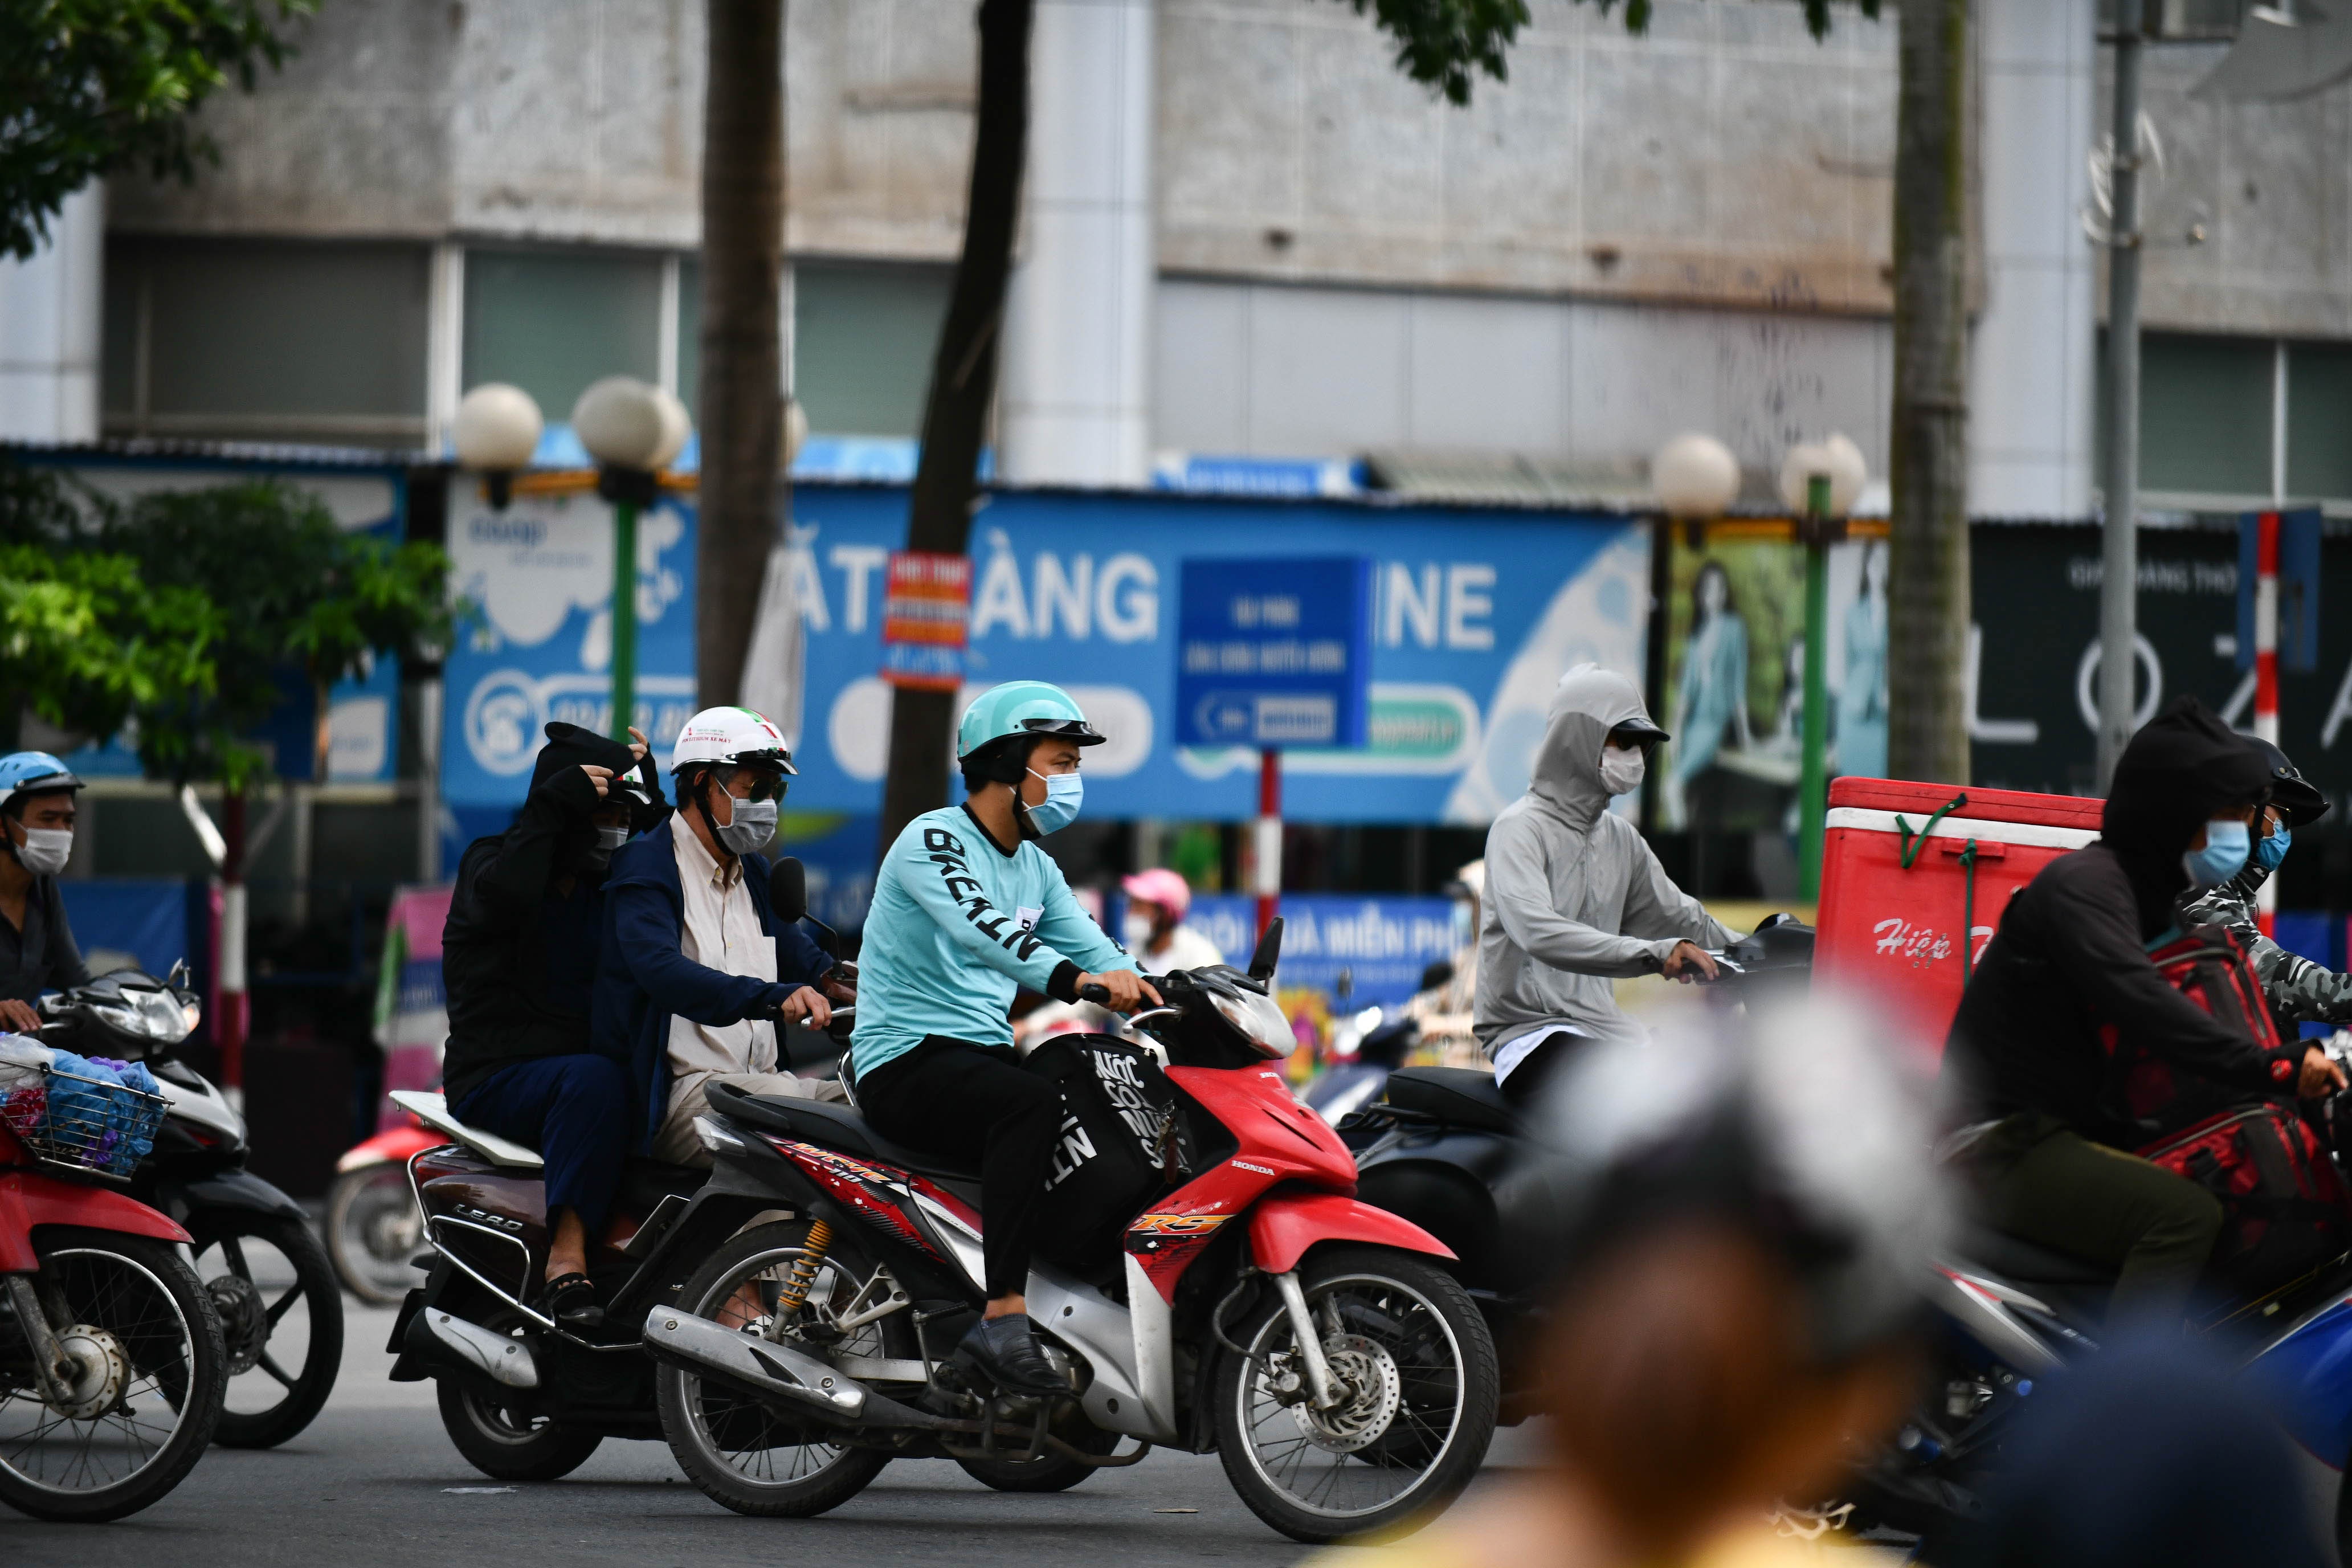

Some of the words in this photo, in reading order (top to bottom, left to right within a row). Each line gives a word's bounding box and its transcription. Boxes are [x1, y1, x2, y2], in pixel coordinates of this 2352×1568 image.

[969, 528, 1159, 642] ÀNG
[1873, 918, 1951, 969] Hiệp
[829, 1167, 863, 1183] 110
[1231, 1160, 1275, 1176] HONDA
[455, 1203, 523, 1231] LEAD
[1128, 1214, 1240, 1235] RS
